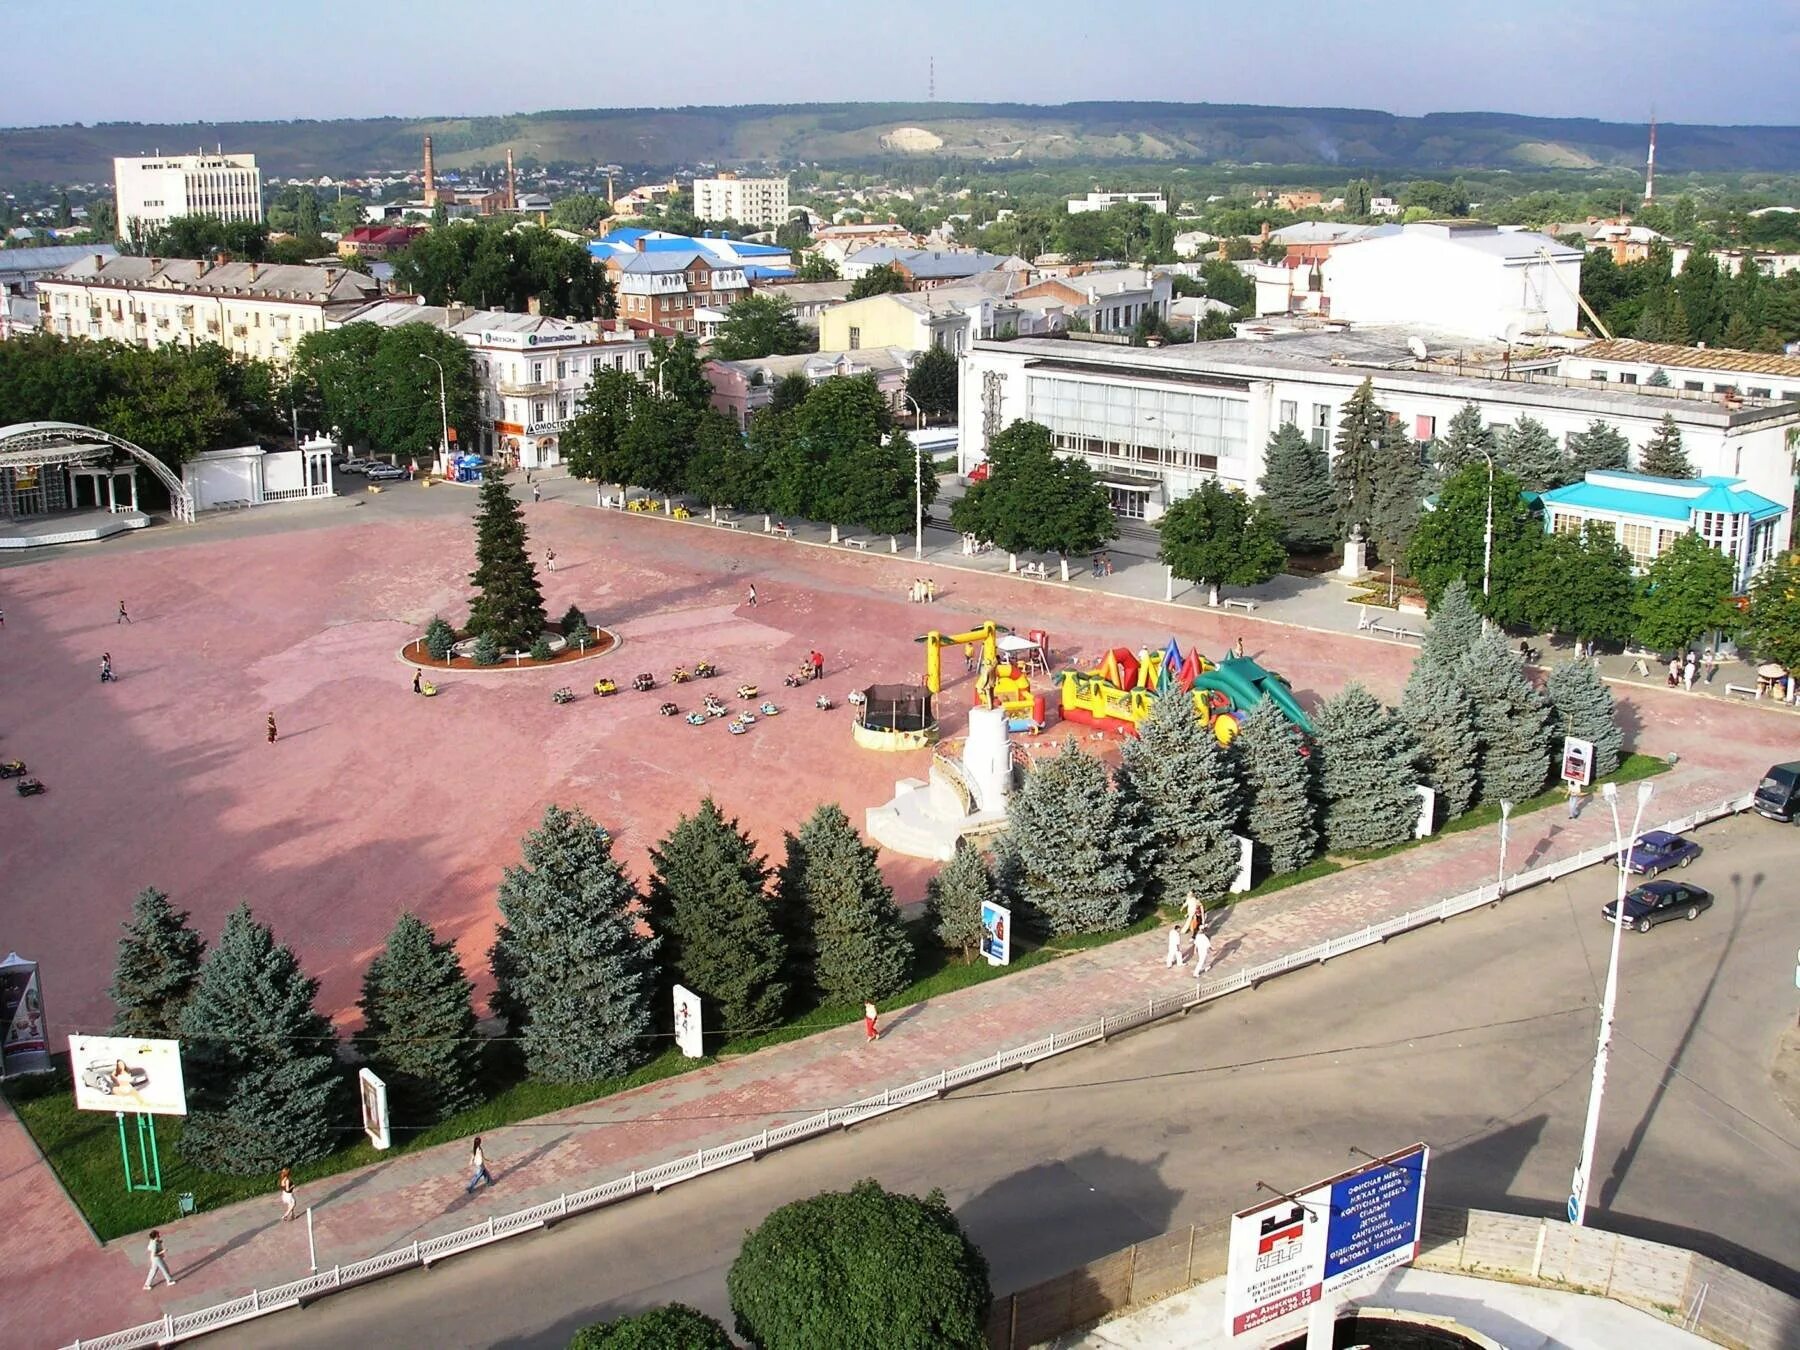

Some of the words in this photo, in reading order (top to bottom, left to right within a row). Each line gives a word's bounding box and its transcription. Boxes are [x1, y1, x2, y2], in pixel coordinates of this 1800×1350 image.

[1348, 1176, 1381, 1195] ОФИСНАЯ
[1350, 1188, 1376, 1203] МЯГКАЯ
[1379, 1179, 1402, 1192] МЕБЕЛЬ
[1341, 1196, 1380, 1218] КОРПУСНАЯ
[1383, 1186, 1406, 1200] МЕБЕЛЬ
[1360, 1201, 1391, 1218] СПАЛЬНИ
[1352, 1219, 1394, 1240] САНТЕХНИКА
[1360, 1211, 1387, 1229] ДЕТСКИЕ
[1375, 1221, 1411, 1239] МАТЕРИАЛЫ
[1255, 1242, 1303, 1272] HELP
[1340, 1248, 1370, 1265] БЫТОВАЯ
[1374, 1234, 1402, 1249] ТЕХНИКА
[1301, 1289, 1311, 1298] 12
